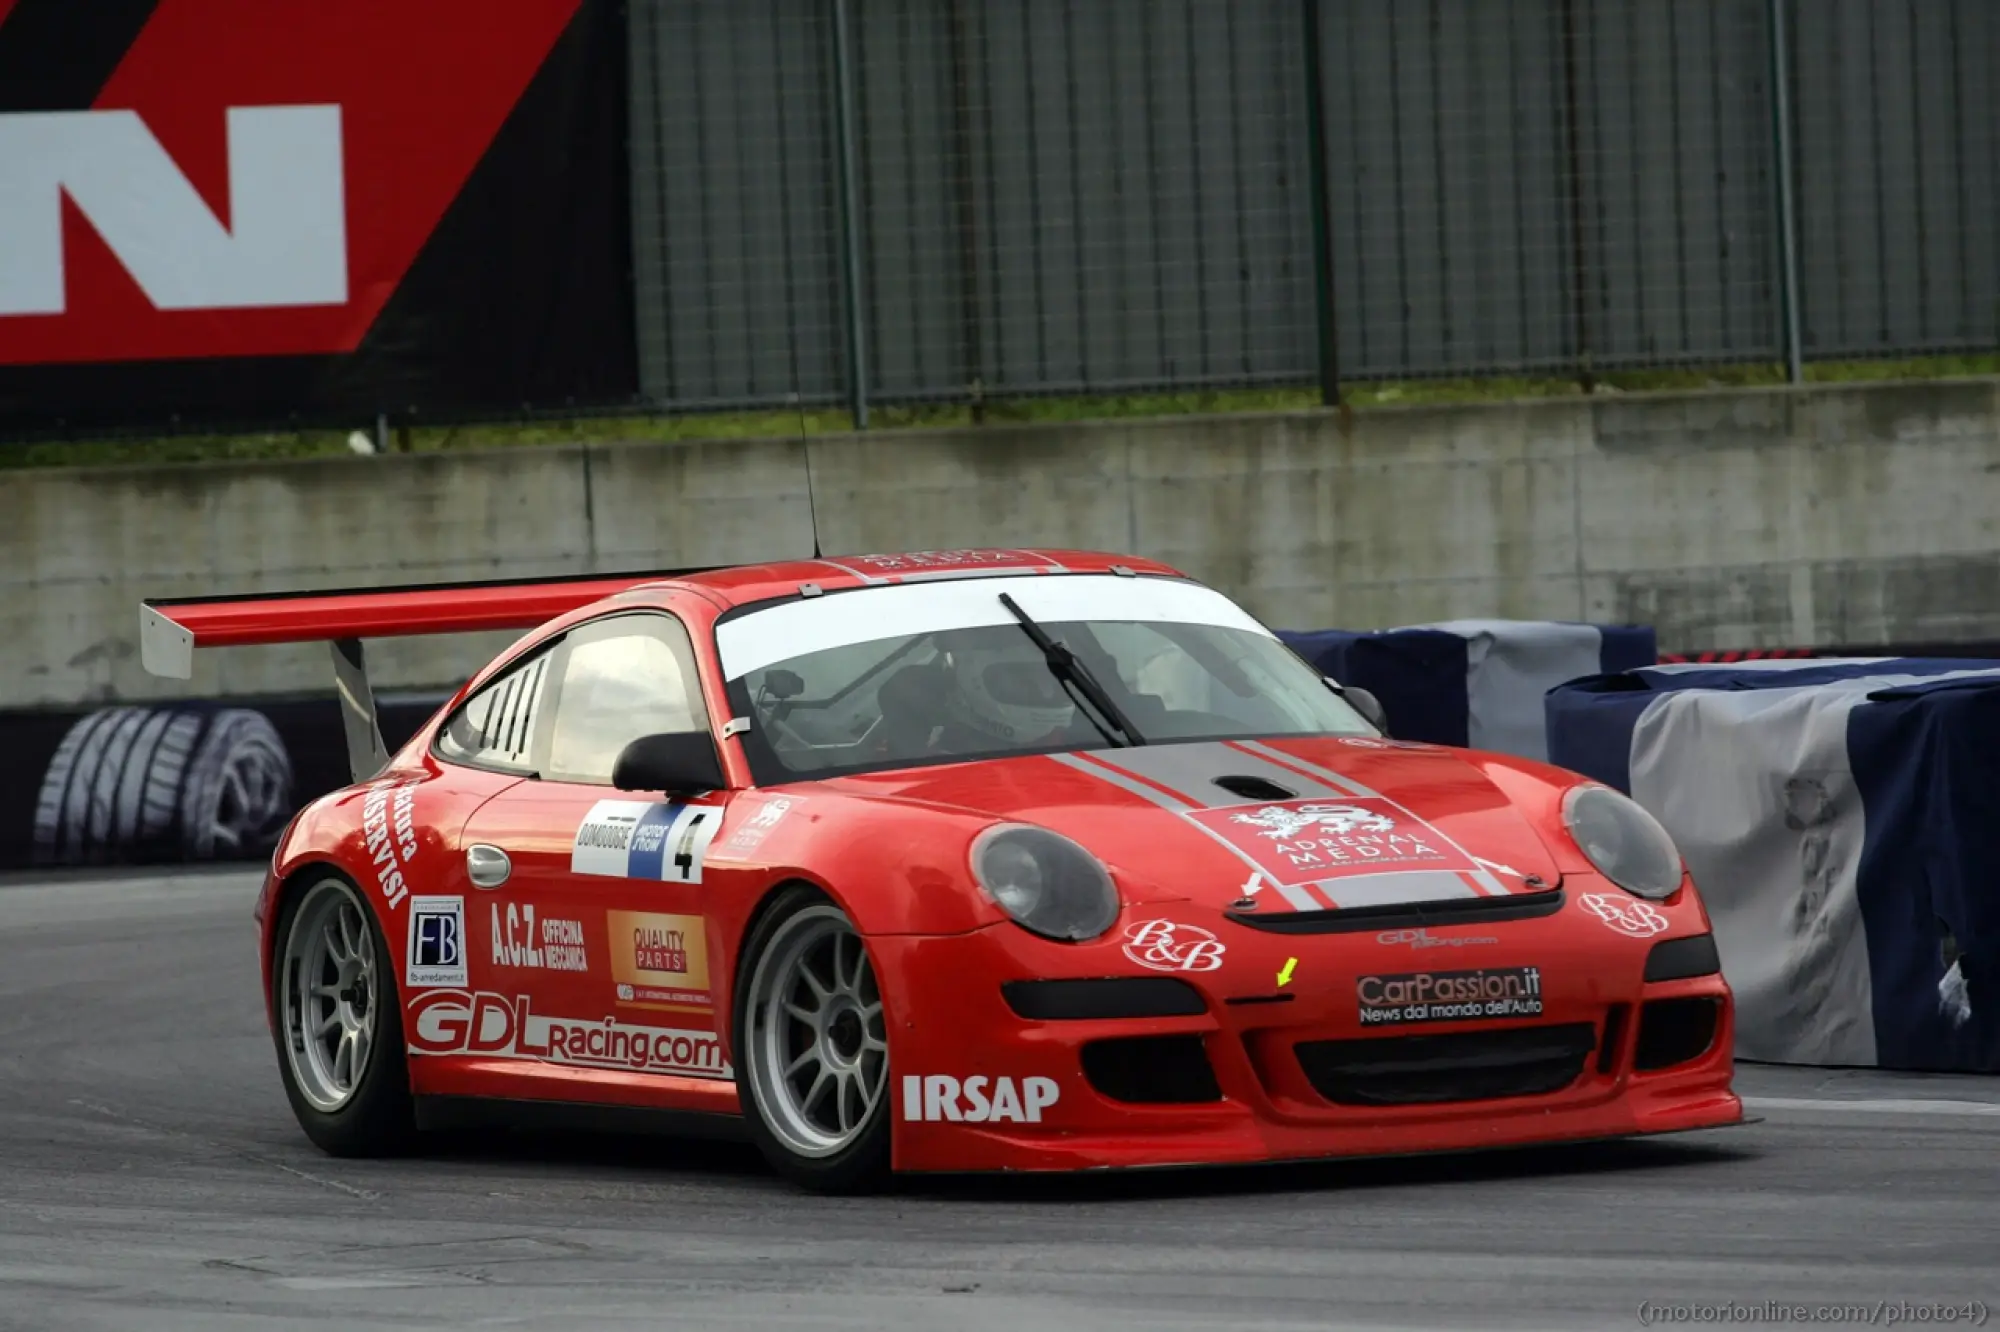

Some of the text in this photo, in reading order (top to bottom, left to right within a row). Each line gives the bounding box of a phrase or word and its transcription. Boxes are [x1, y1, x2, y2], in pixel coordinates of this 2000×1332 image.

[674, 813, 707, 880] 4
[1276, 832, 1426, 854] ADRENAL
[1288, 843, 1439, 865] MEDIA
[1578, 891, 1670, 938] B&B
[415, 913, 459, 966] FB
[542, 918, 585, 946] OFFICINA
[633, 927, 685, 951] QUALITY
[1122, 918, 1227, 972] B&B
[637, 950, 682, 970] PARTS
[1357, 967, 1541, 1006] CarPassion.it
[1360, 998, 1543, 1023] News dal mondo dell'Auto
[902, 1074, 1061, 1123] IRSAP
